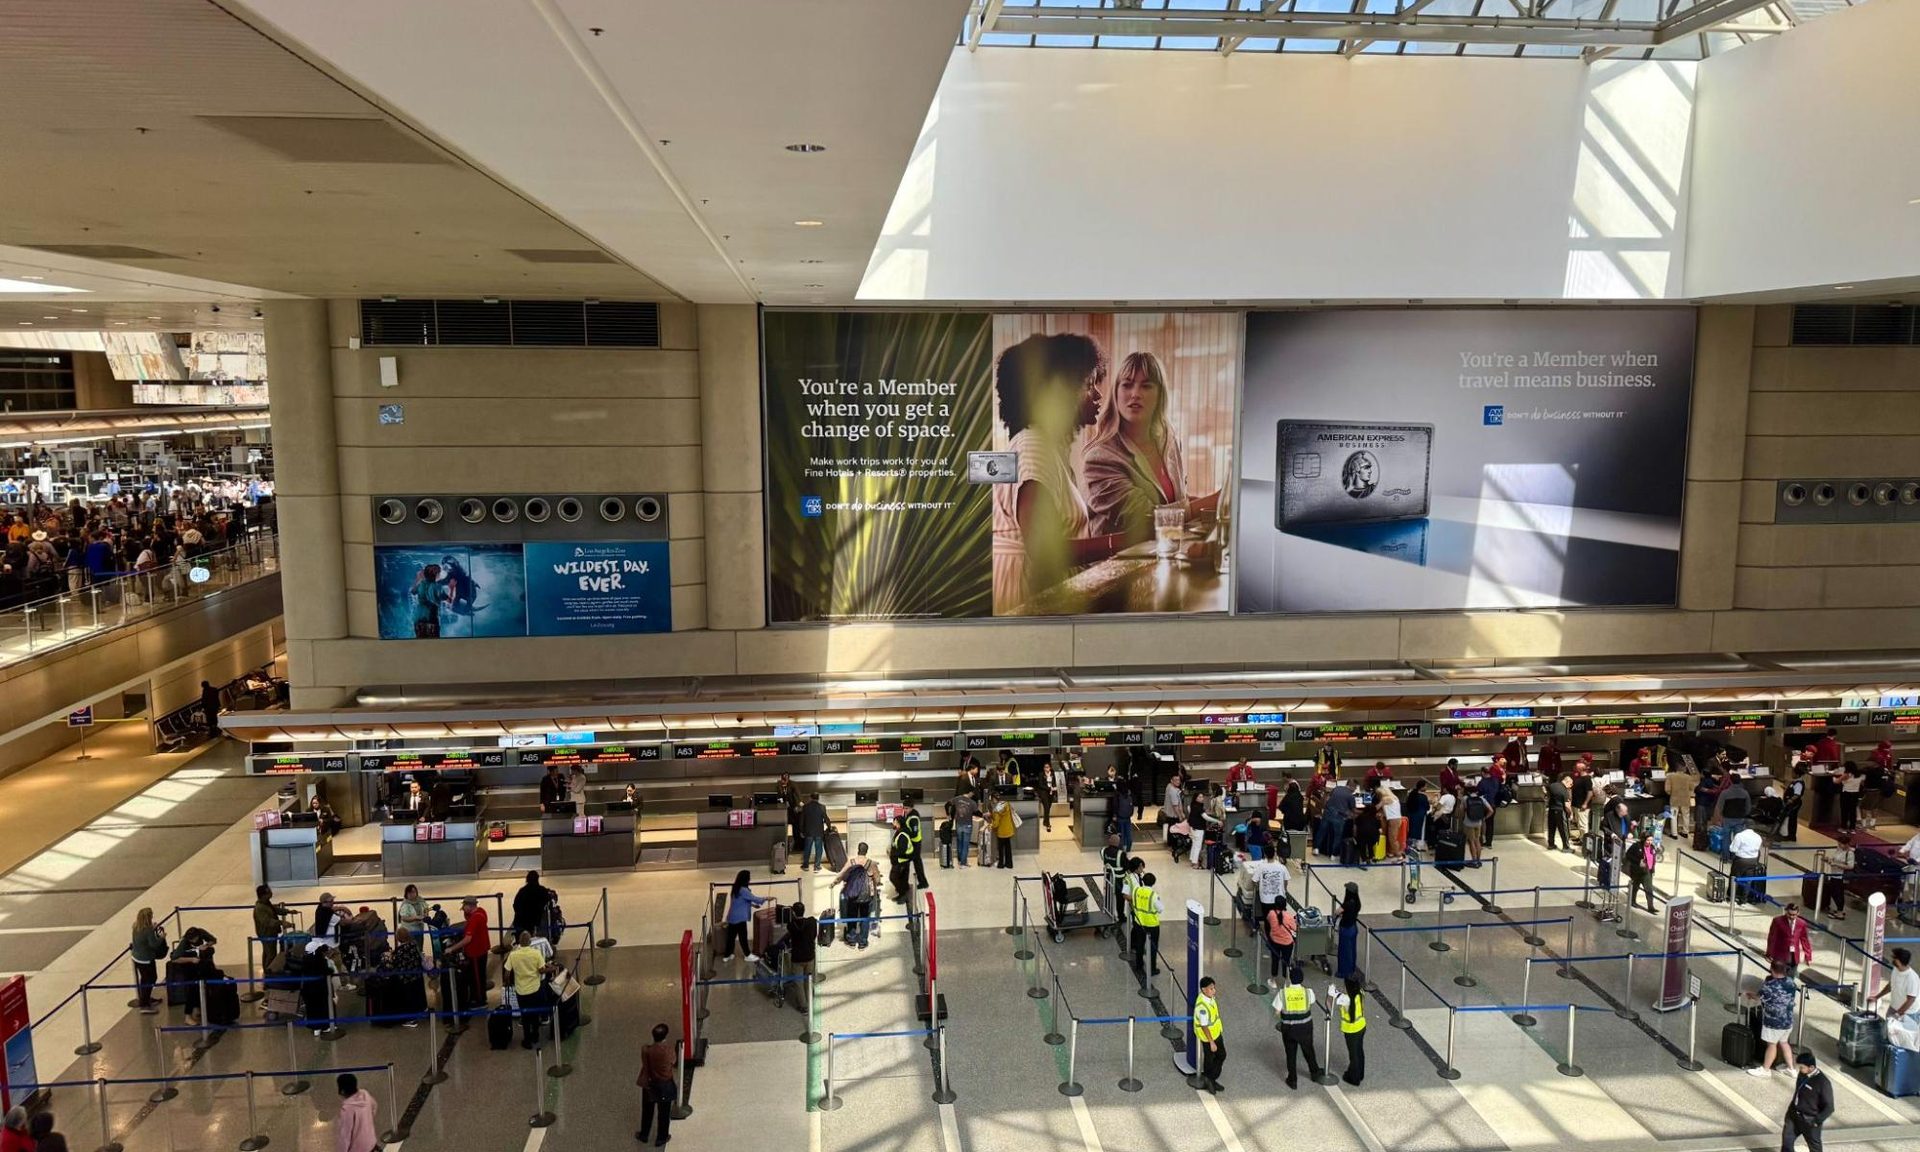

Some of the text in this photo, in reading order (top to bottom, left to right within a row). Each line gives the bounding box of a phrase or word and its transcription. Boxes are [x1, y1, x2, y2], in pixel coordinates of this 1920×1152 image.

[1459, 350, 1658, 367] You're a Member when
[798, 378, 958, 396] You're a Member
[1459, 371, 1656, 388] travel means business.
[807, 400, 950, 420] when you get a
[801, 421, 955, 441] change of space.
[1367, 434, 1406, 442] EXPRESS
[810, 457, 835, 465] Make
[836, 457, 858, 465] work
[860, 457, 880, 466] trips
[882, 457, 904, 465] work
[906, 457, 918, 465] for
[921, 459, 937, 467] you
[805, 468, 824, 477] Fine
[825, 468, 854, 477] Hotels
[851, 497, 863, 512] do
[865, 500, 906, 511] business
[579, 573, 626, 592] EVER.
